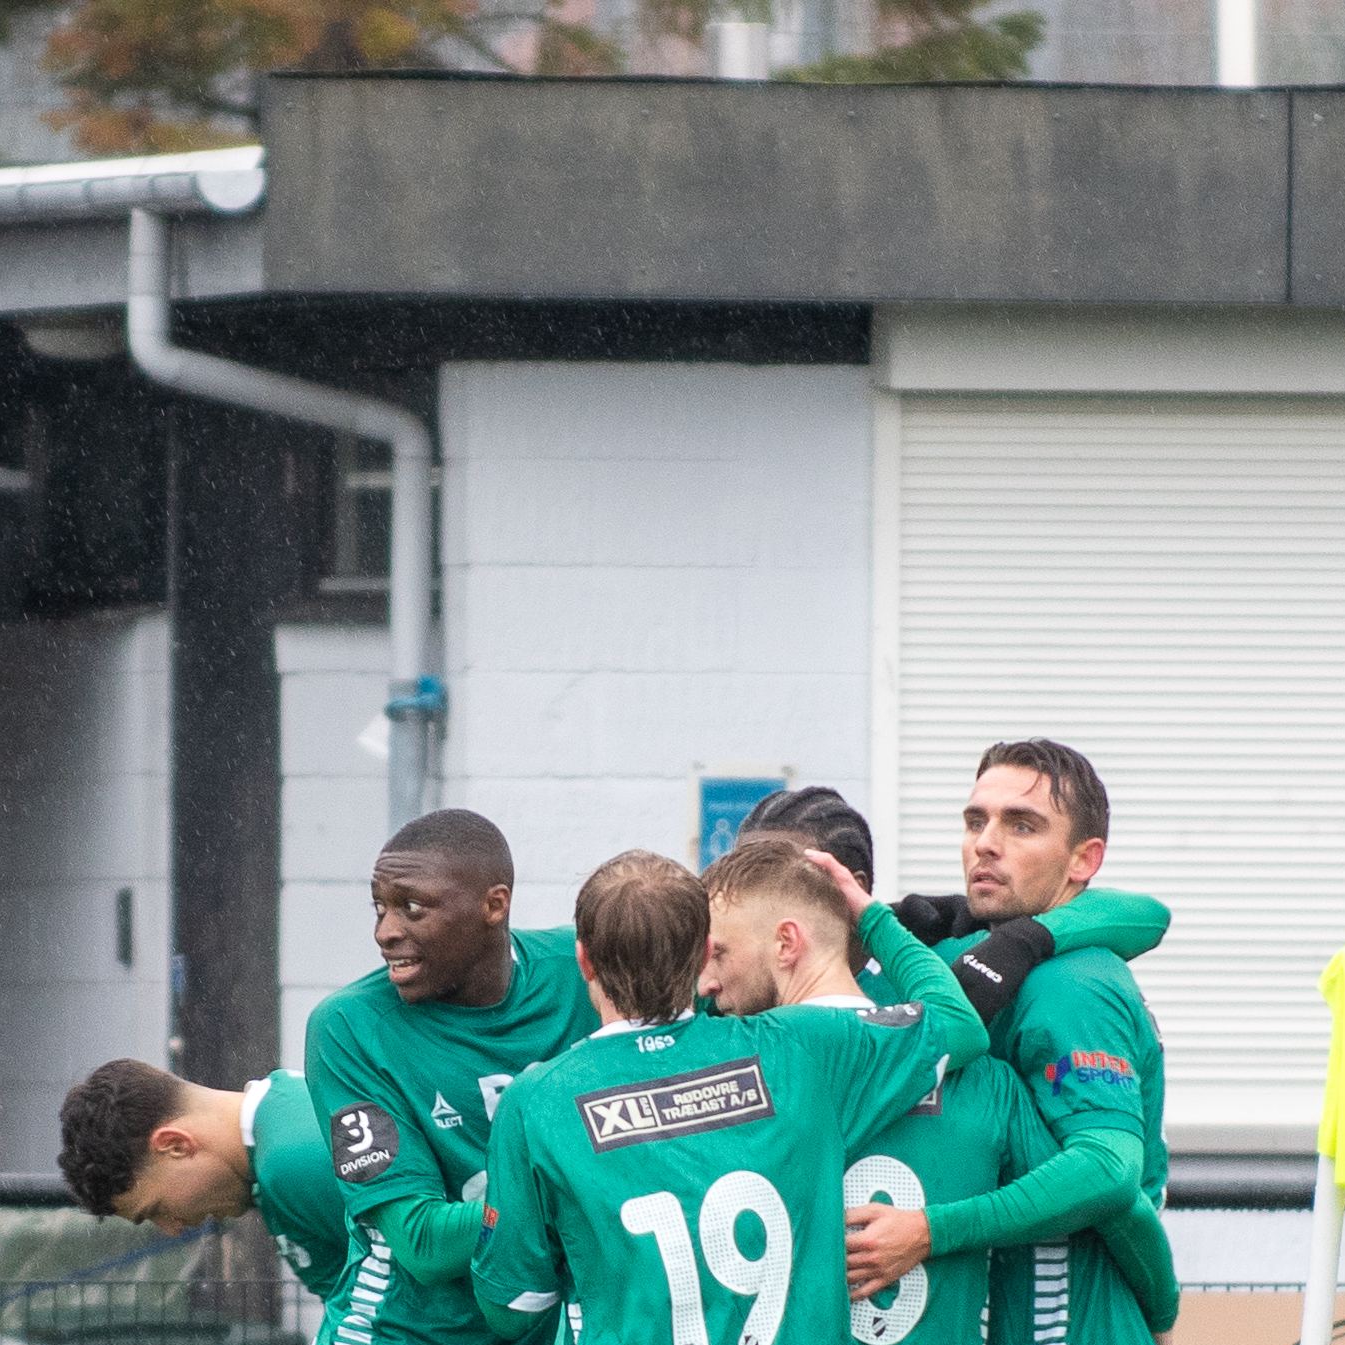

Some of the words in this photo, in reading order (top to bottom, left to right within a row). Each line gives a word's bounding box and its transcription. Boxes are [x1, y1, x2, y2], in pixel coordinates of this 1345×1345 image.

[661, 1097, 727, 1121] TRÆLAST
[729, 1088, 759, 1107] A/S
[672, 1080, 739, 1106] RØDOVRE
[341, 1110, 374, 1153] 3
[592, 1098, 656, 1137] XL
[340, 1149, 391, 1176] DIVISION
